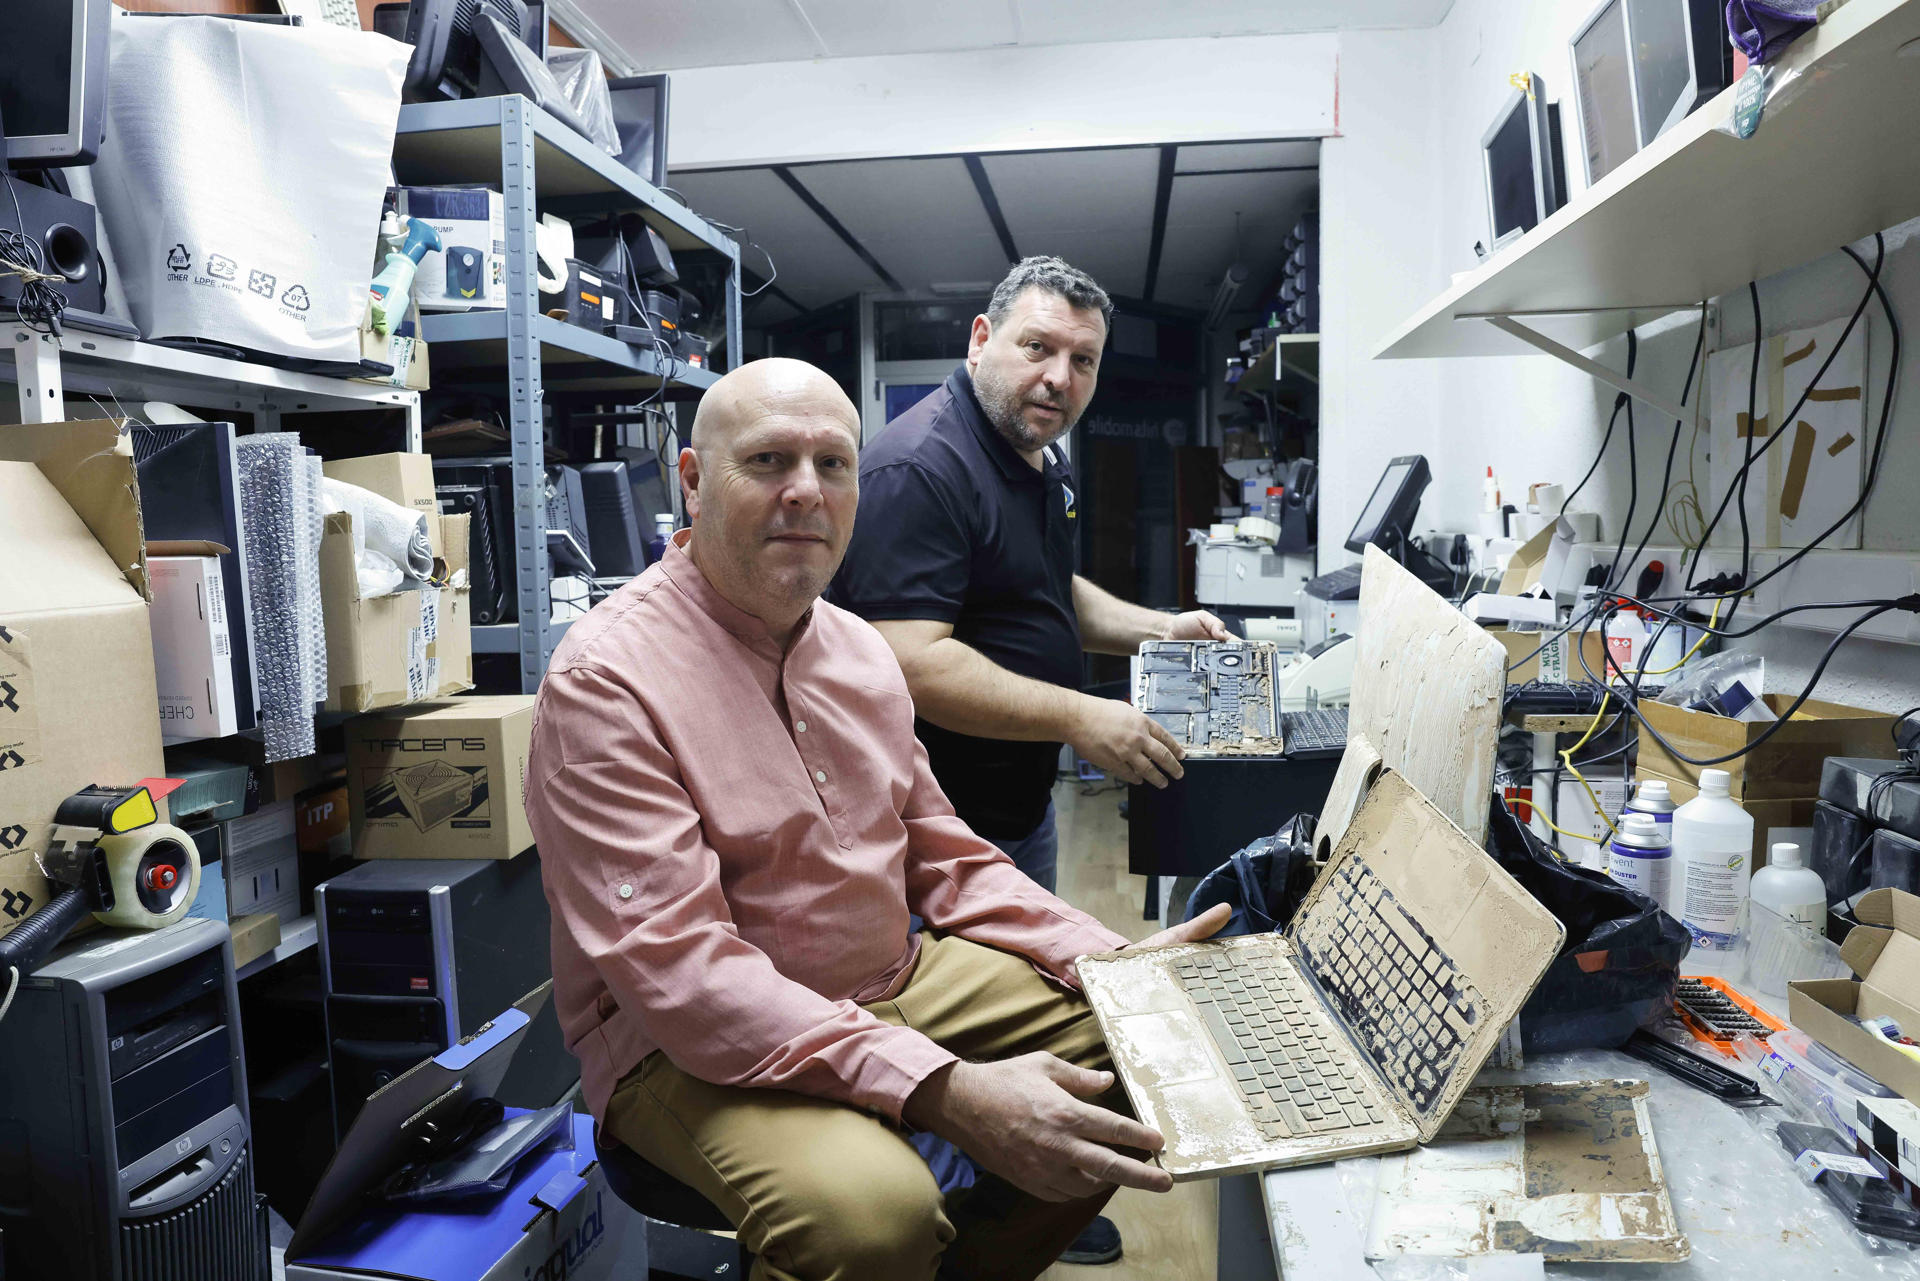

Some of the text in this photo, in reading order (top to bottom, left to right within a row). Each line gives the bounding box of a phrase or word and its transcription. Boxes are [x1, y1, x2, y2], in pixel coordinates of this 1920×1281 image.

[167, 274, 189, 282] OTHER
[194, 276, 216, 286] LDPE
[291, 294, 302, 303] 07
[278, 307, 307, 322] OTHER
[361, 738, 486, 752] TACENS
[307, 802, 334, 826] ITP
[1614, 870, 1638, 880] DUSTER
